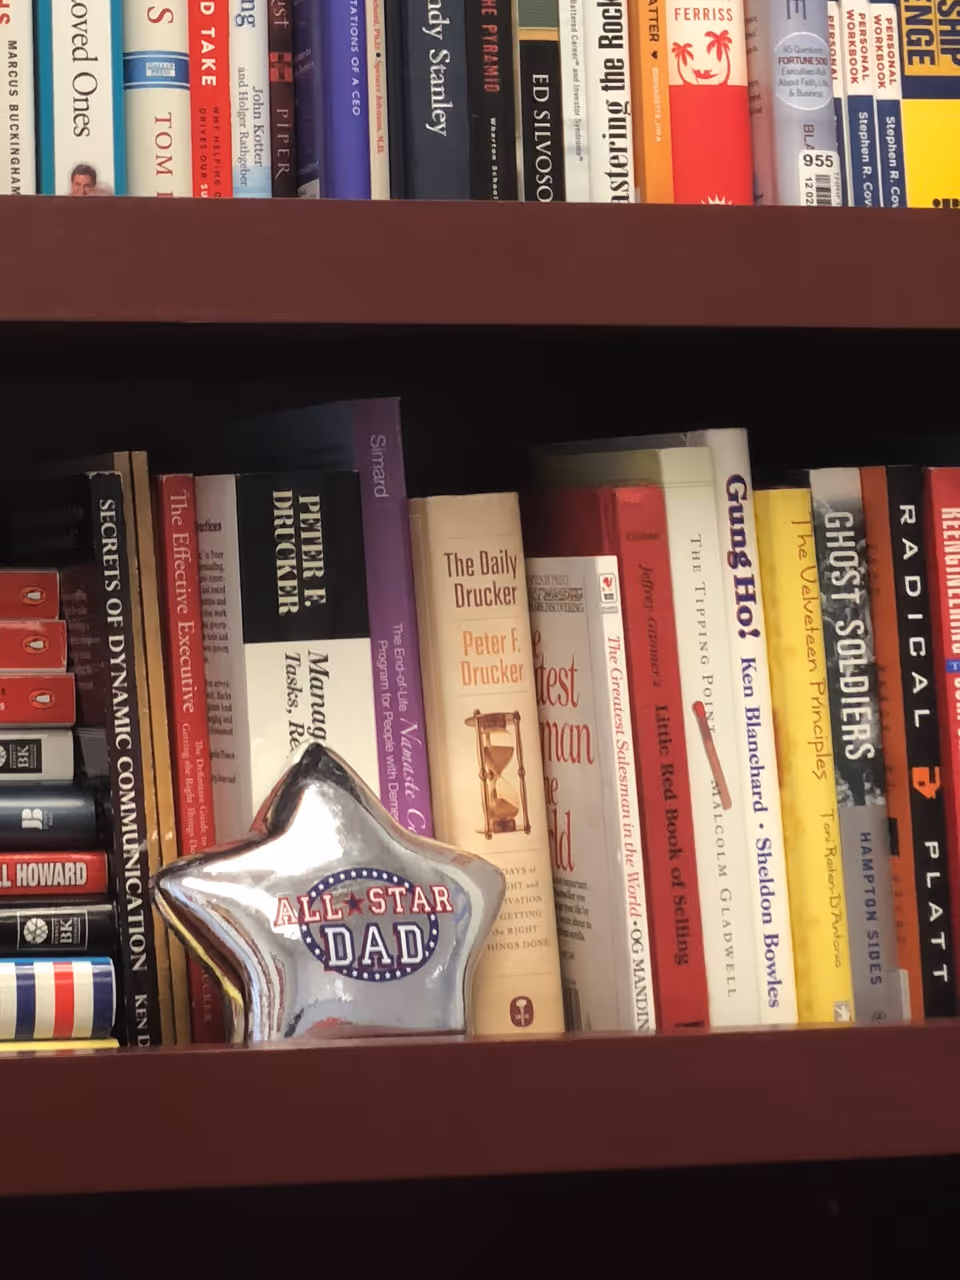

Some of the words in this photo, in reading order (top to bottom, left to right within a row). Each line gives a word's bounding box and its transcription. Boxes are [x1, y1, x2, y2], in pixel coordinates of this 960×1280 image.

[674, 8, 733, 21] FERRISS
[7, 40, 19, 97] MARCUS
[200, 28, 216, 87] TAKE
[72, 71, 98, 137] Ones
[252, 86, 261, 113] John
[426, 49, 453, 136] Stanley
[253, 118, 265, 167] Kotter
[803, 154, 834, 167] 955
[370, 434, 389, 498] Simard
[170, 490, 188, 525] The
[725, 474, 752, 569] Gung
[99, 499, 121, 592] SECRETS
[172, 532, 192, 615] Effective
[444, 552, 474, 577] The
[479, 550, 517, 579] Daily
[690, 533, 701, 573] THE
[824, 511, 860, 604] GHOST
[106, 598, 123, 627] OF
[454, 581, 517, 608] Drucker
[695, 582, 710, 665] TIPPING
[733, 573, 761, 639] Ho!
[899, 504, 930, 728] RADICAL
[177, 621, 198, 713] Executive
[462, 631, 506, 656] Peter
[511, 627, 521, 654] F.
[608, 635, 620, 664] The
[108, 635, 132, 750] DYNAMIC
[284, 652, 303, 714] Tasks,
[610, 668, 626, 735] Greatest
[702, 674, 715, 734] POINT
[740, 656, 757, 698] Ken
[834, 619, 875, 760] SOLDIERS
[615, 739, 632, 820] Salesman
[744, 706, 768, 813] Blanchard
[622, 822, 632, 836] in
[623, 841, 634, 868] the
[16, 862, 87, 889] HOWARD
[116, 756, 147, 971] COMMUNICATION
[755, 837, 775, 924] Sheldon
[273, 893, 343, 927] ALL
[367, 884, 454, 915] STAR
[627, 871, 641, 918] World
[924, 840, 948, 982] PLATT
[320, 921, 426, 972] DAD
[763, 933, 783, 1008] Bowles
